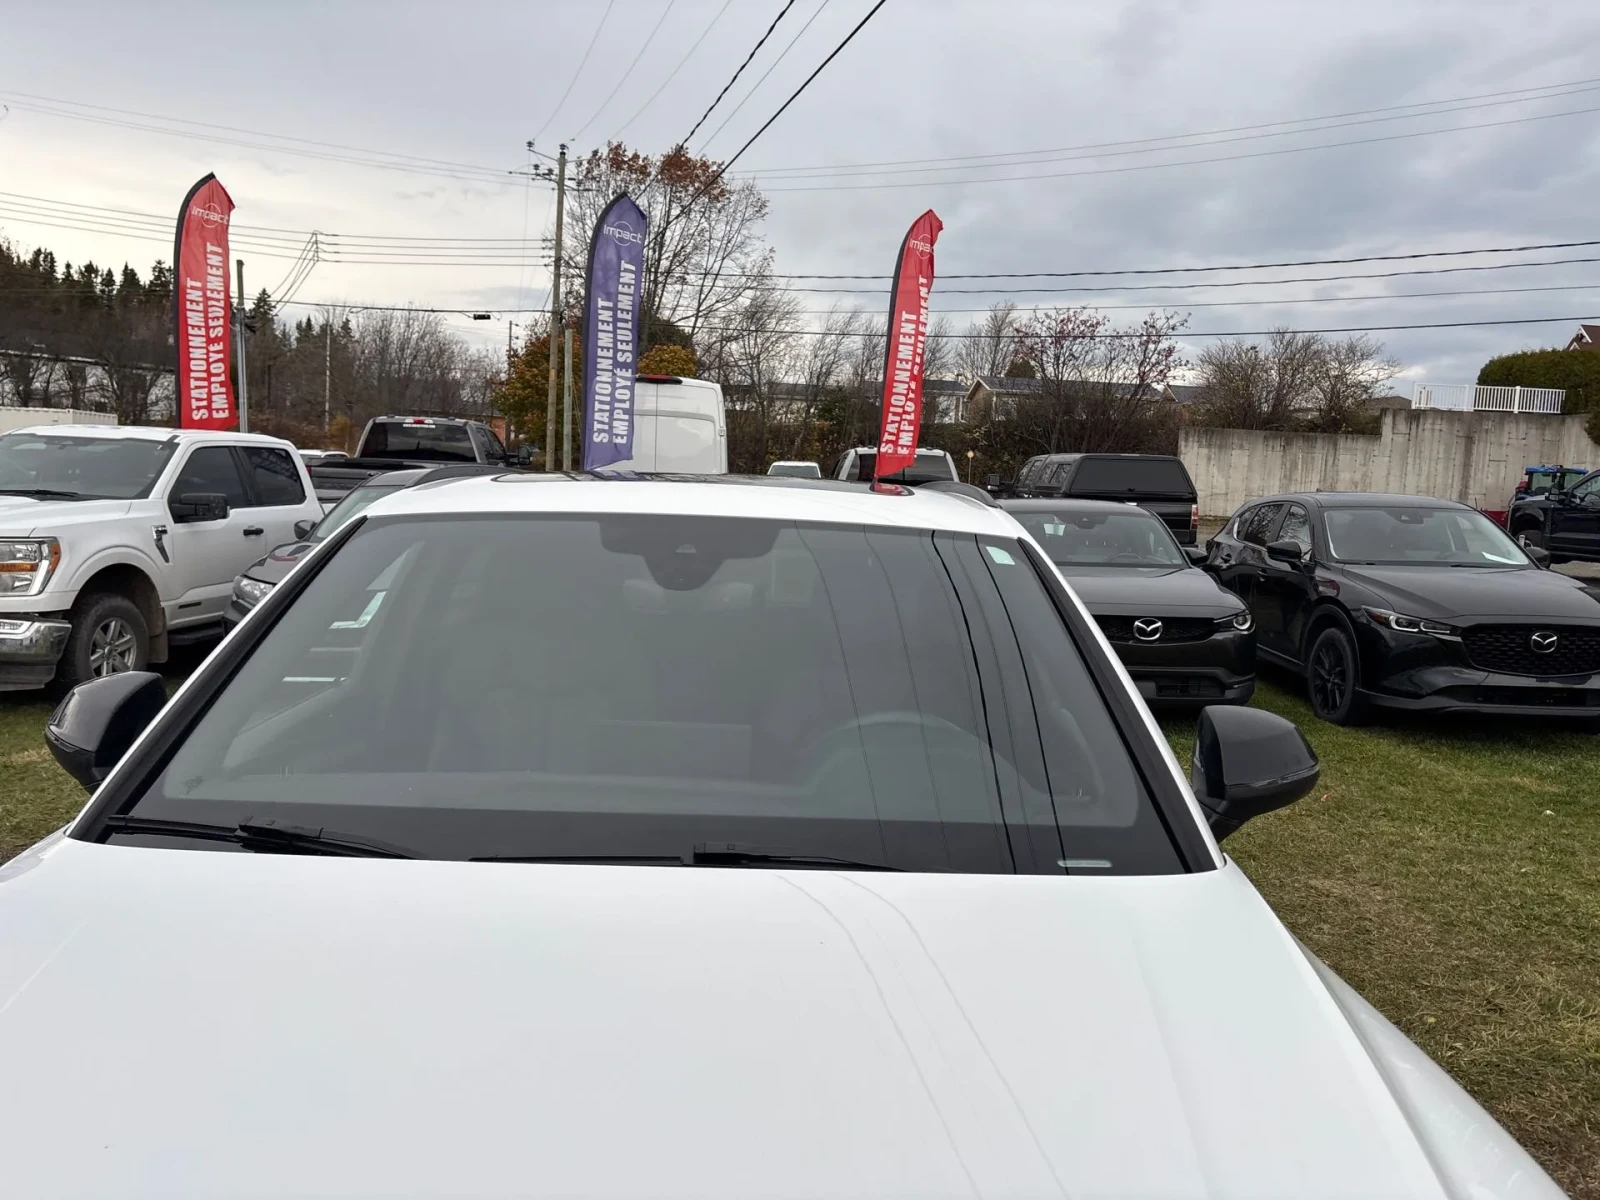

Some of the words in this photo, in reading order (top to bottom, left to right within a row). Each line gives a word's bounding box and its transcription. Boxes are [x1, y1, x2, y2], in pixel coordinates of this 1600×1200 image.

[186, 277, 209, 420] STATIONNEMENT
[206, 242, 225, 338] SEULEMENT
[617, 260, 636, 363] SEULEMENT
[593, 298, 614, 443] STATIONNEMENT
[613, 368, 633, 444] EMPLOYÉ
[880, 311, 917, 453] STATIONNEMENT
